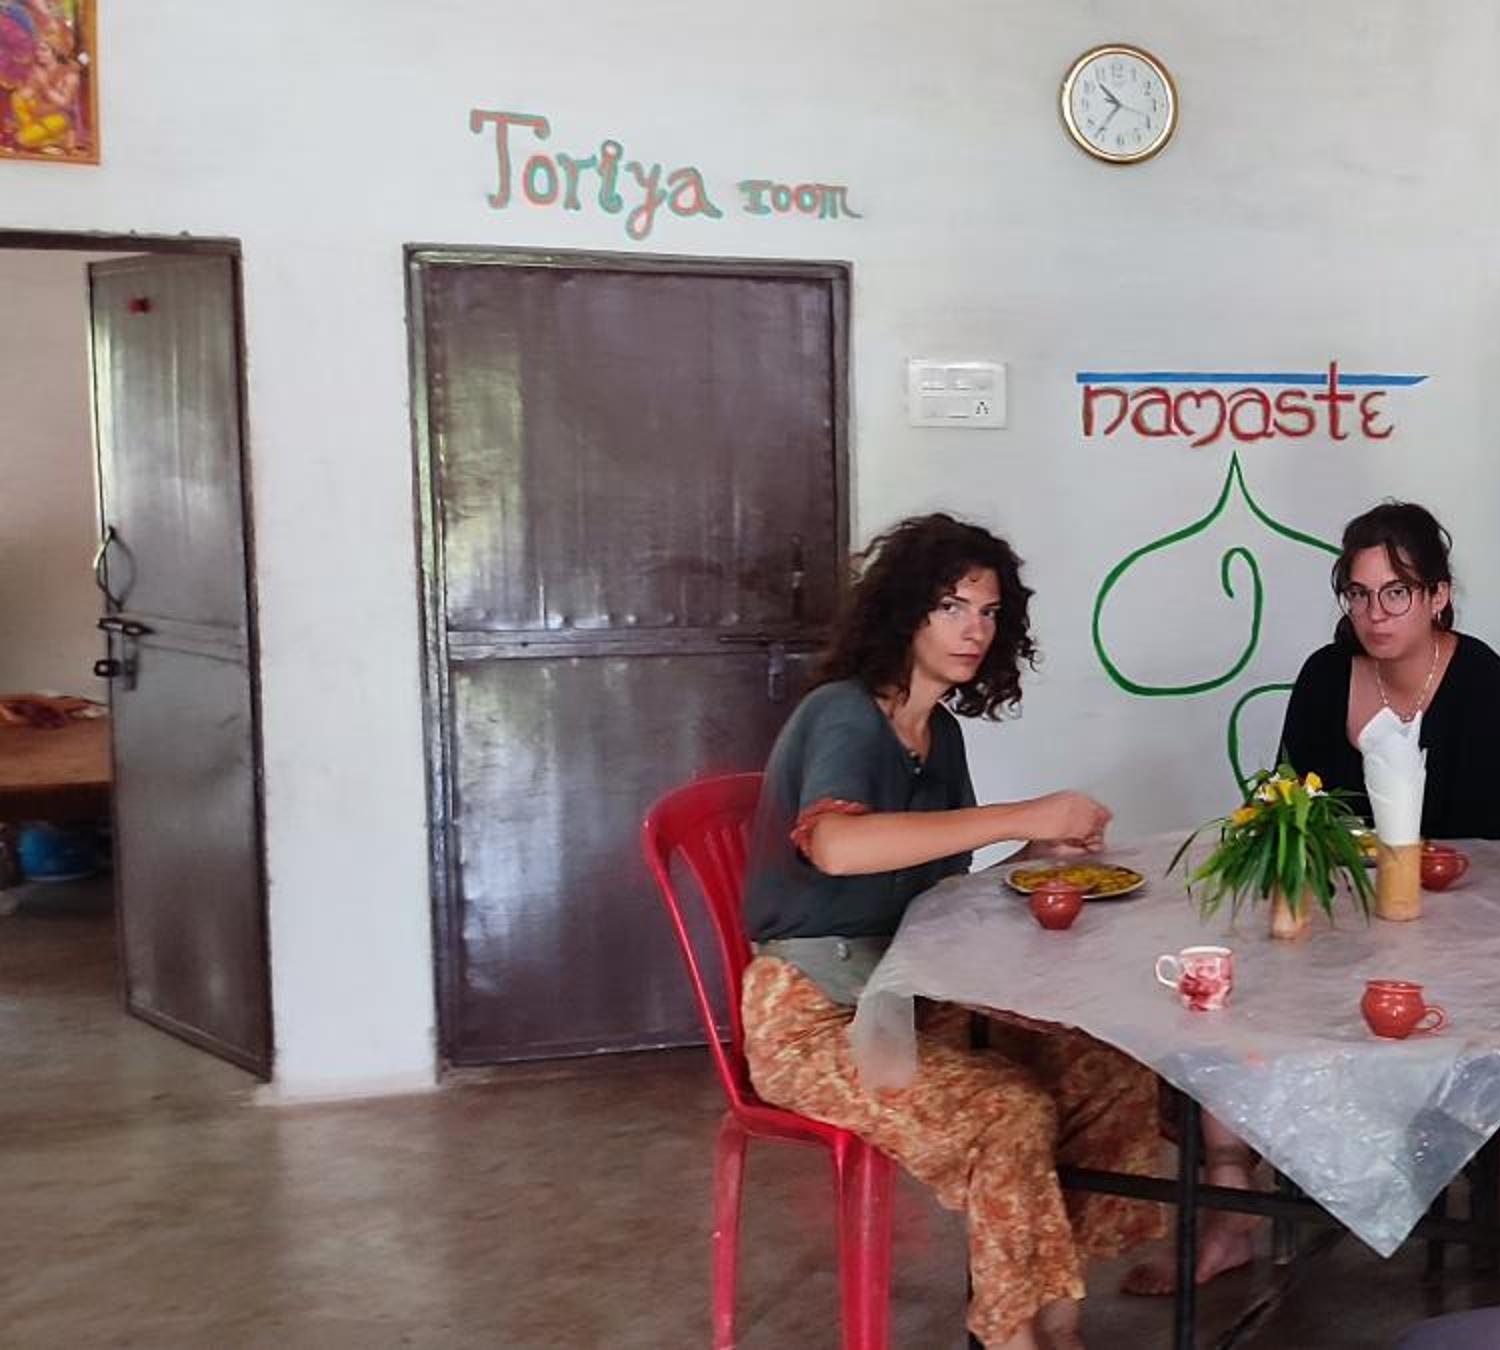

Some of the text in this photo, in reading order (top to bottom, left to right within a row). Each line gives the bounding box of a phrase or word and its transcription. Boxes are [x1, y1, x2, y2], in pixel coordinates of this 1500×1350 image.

[470, 109, 863, 241] Toriya room
[1082, 361, 1394, 448] namaste
